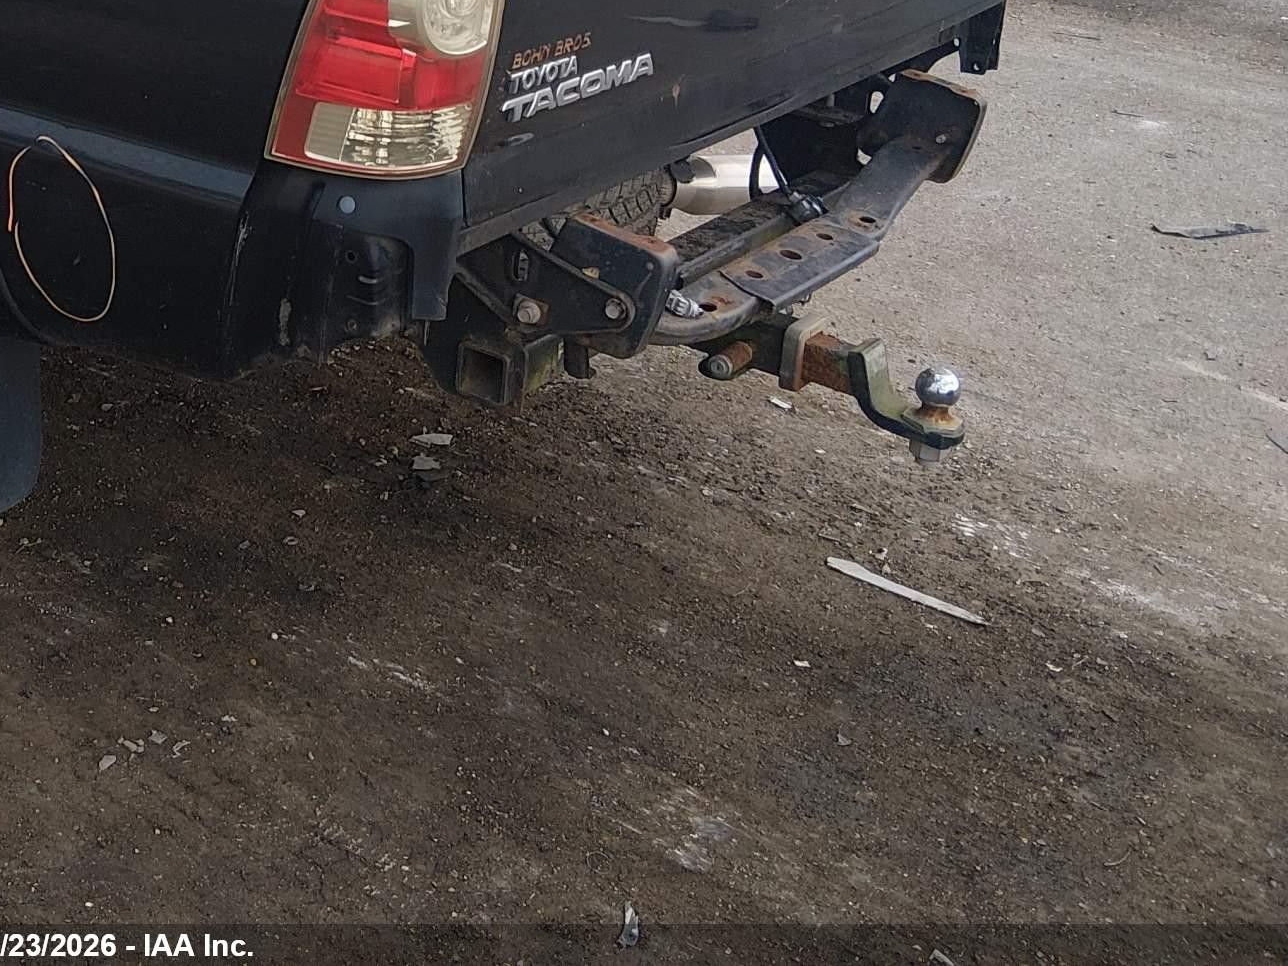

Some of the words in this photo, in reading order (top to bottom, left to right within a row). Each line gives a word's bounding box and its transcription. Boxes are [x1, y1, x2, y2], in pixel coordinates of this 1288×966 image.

[508, 55, 578, 94] TOYOTA
[512, 44, 551, 69] BOHN
[501, 52, 654, 122] TACOMA
